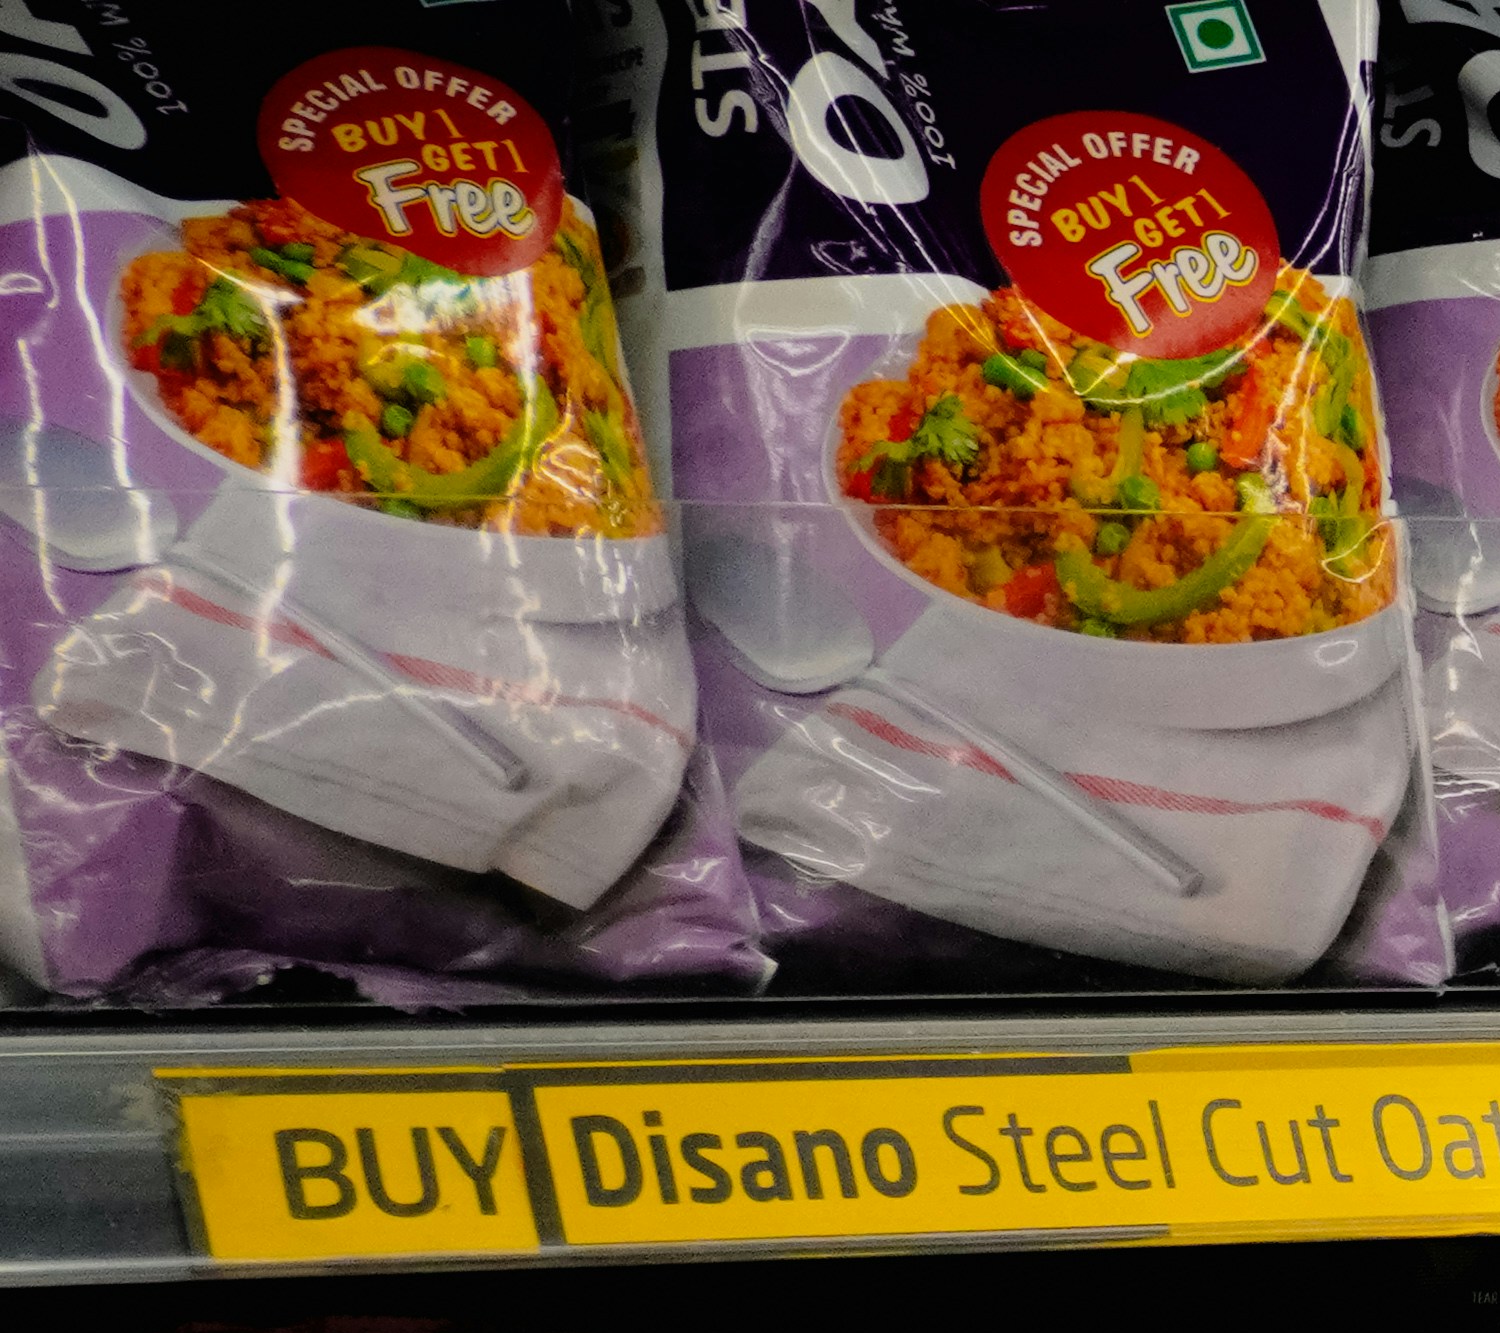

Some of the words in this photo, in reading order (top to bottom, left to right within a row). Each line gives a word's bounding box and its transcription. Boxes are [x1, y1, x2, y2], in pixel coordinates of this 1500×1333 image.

[279, 64, 389, 153] SPECIAL
[395, 64, 520, 130] OFFER
[331, 112, 428, 154] BUY
[353, 159, 539, 238] Free
[422, 141, 500, 175] GET
[1008, 141, 1082, 247] SPECIAL
[1082, 131, 1201, 175] OFFER
[1050, 189, 1130, 244] BUY
[1132, 205, 1208, 249] GET
[1088, 231, 1259, 335] Free
[273, 1125, 509, 1222] BUY
[569, 1109, 918, 1209] Disano
[942, 1098, 1176, 1196] Steel
[1202, 1096, 1354, 1187] Cut
